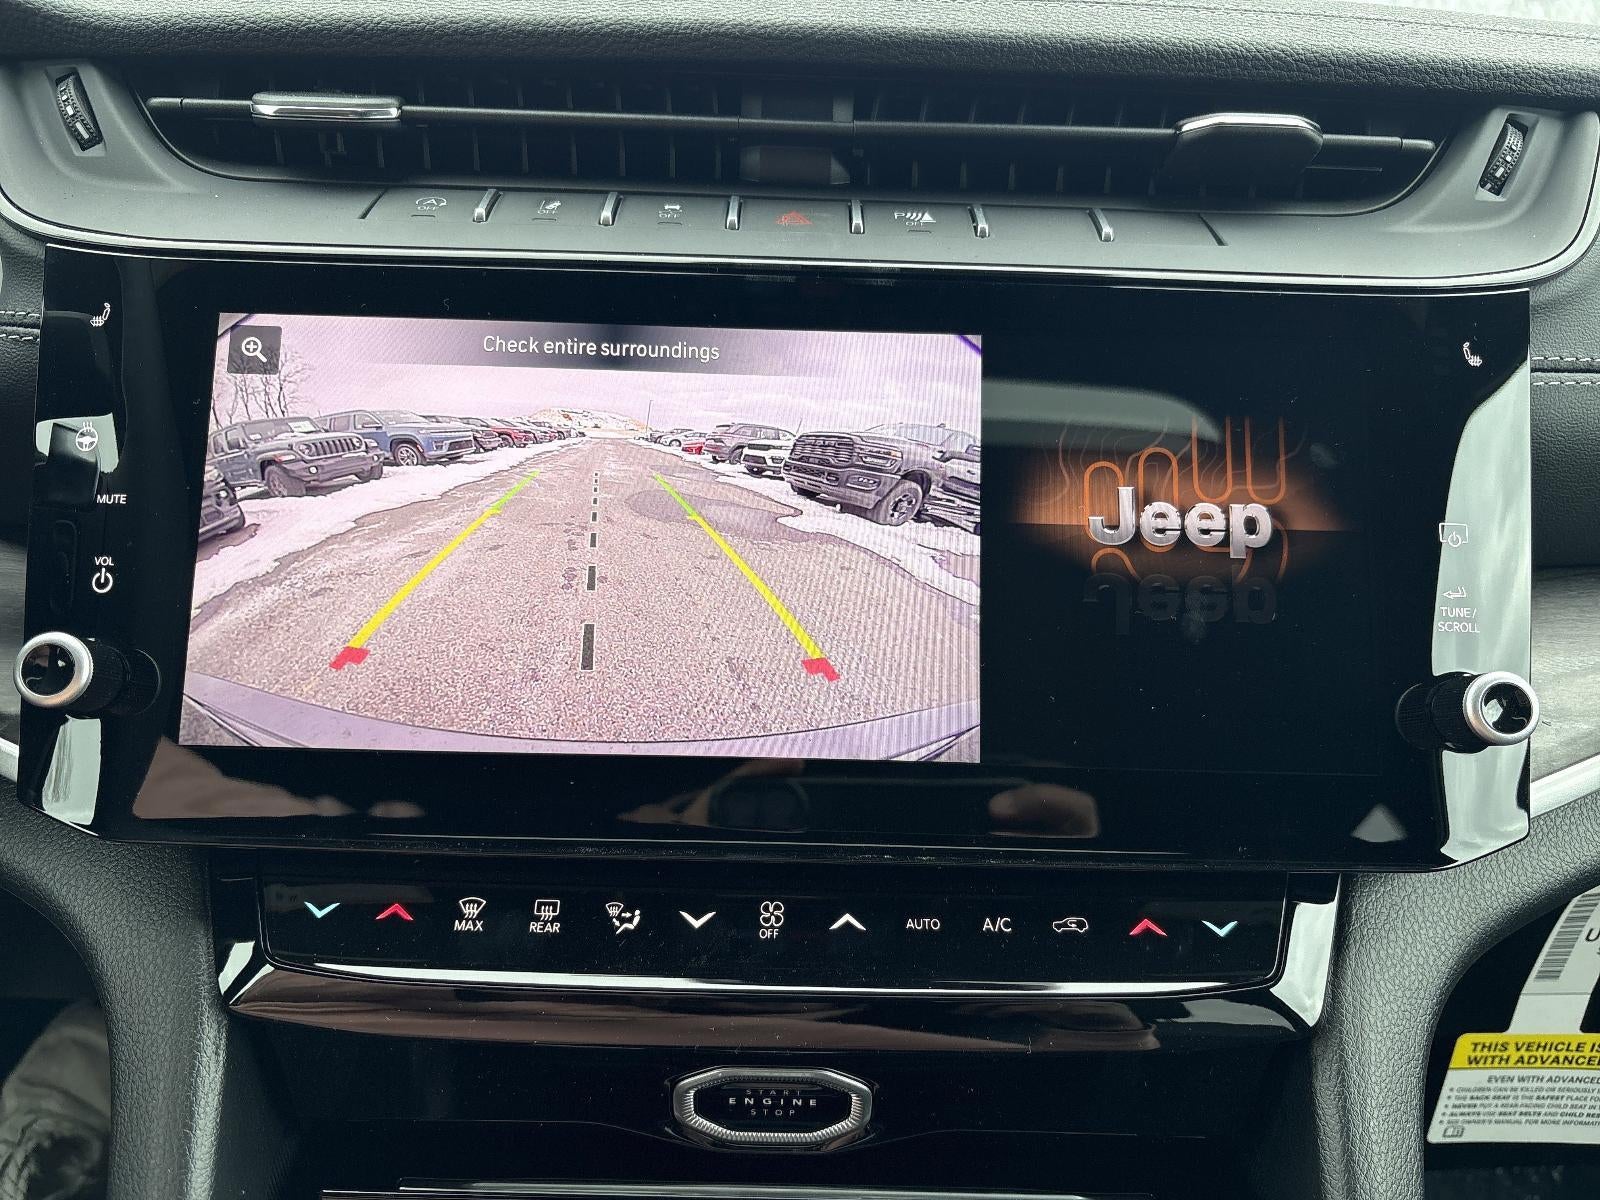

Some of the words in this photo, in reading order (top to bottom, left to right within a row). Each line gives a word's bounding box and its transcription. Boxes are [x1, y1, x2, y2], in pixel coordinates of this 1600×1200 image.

[483, 335, 539, 354] Check
[543, 337, 597, 356] entire
[600, 339, 720, 363] surroundings
[96, 494, 127, 505] MUTE
[1088, 486, 1273, 559] Jeep
[94, 556, 115, 567] VOL
[1439, 605, 1478, 619] TUNE/
[1437, 620, 1481, 633] SCROLL
[453, 919, 484, 932] MAX
[529, 921, 561, 933] REAR
[905, 917, 941, 930] AUTO
[982, 917, 1012, 932] A/C
[758, 928, 779, 940] OFF
[1471, 1041, 1509, 1053] THIS
[1514, 1041, 1587, 1053] VEHICLE
[1466, 1054, 1511, 1066] WITH
[1487, 1074, 1516, 1084] EVEN
[1517, 1074, 1545, 1084] WITH
[728, 1097, 817, 1107] ENGINE
[750, 1108, 796, 1117] STOP
